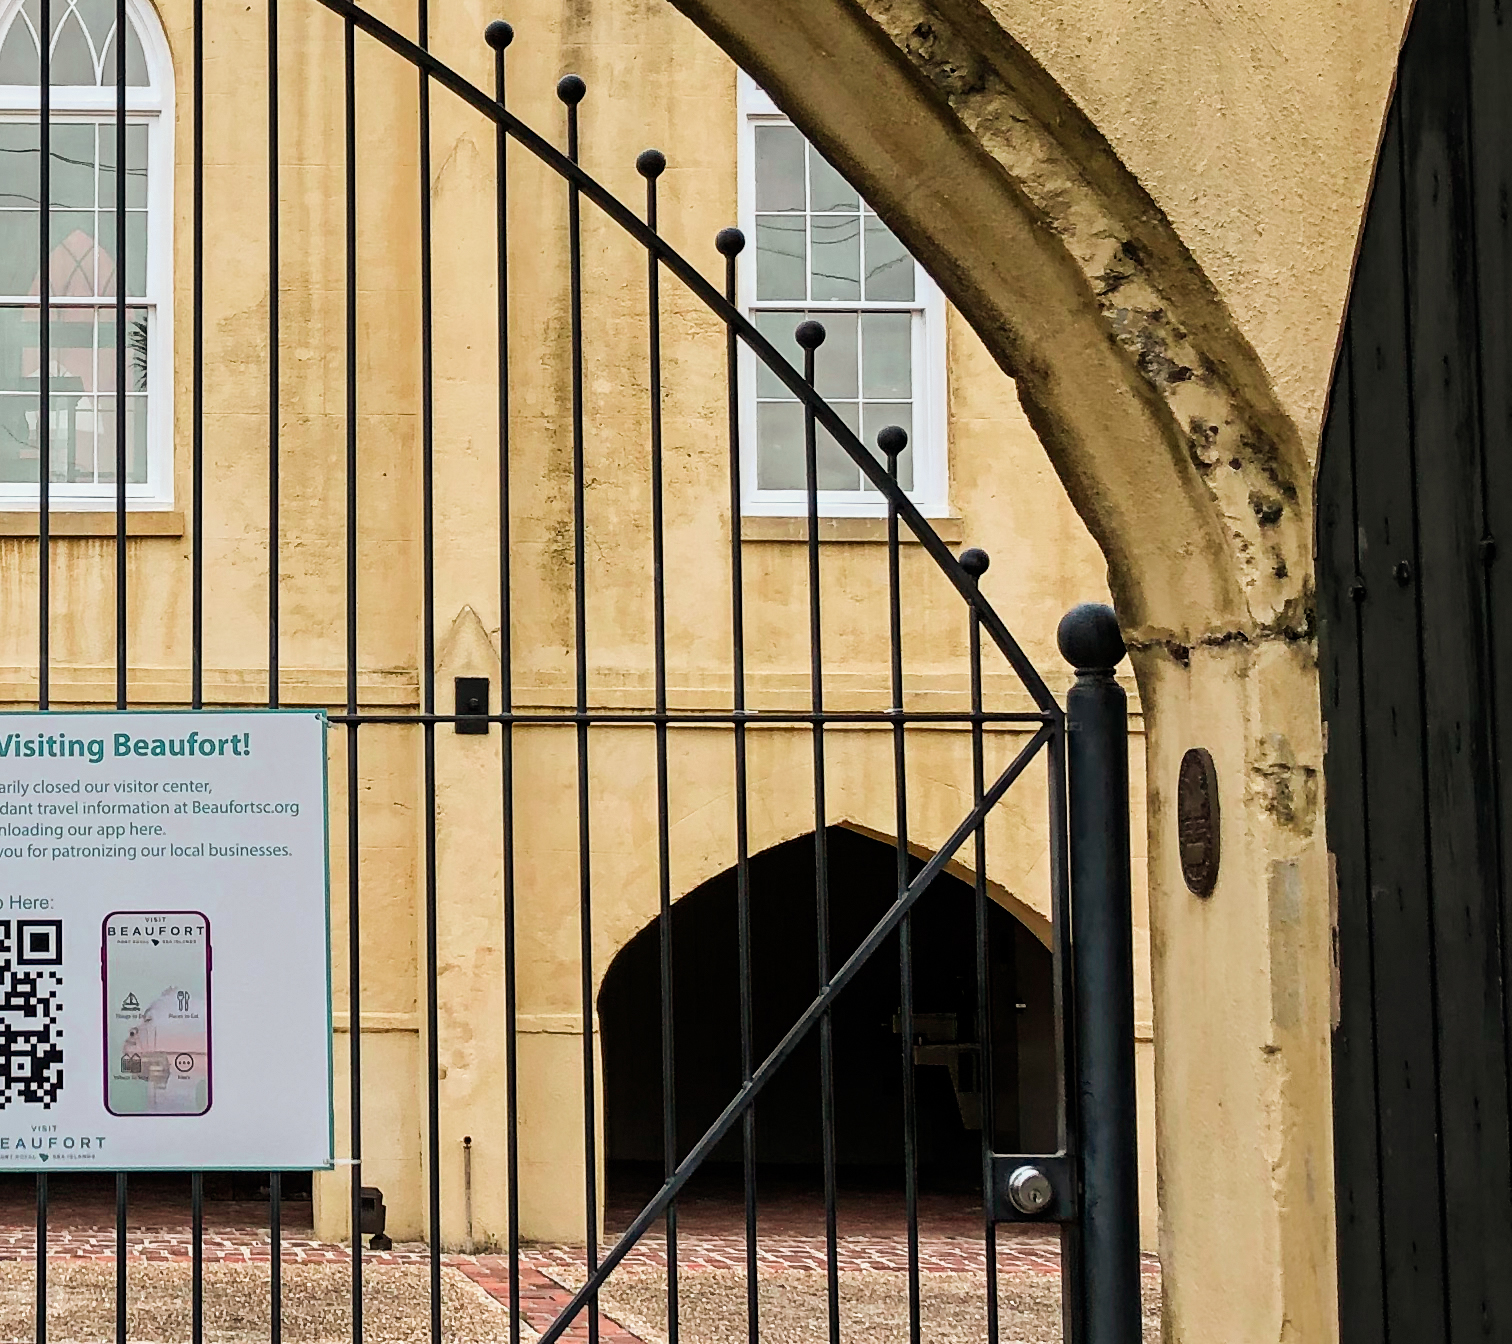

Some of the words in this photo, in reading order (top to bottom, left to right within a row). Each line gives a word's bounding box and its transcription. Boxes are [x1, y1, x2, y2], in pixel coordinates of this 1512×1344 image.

[113, 731, 251, 757] Beaufort!
[33, 780, 80, 794] closed
[85, 783, 110, 793] our
[114, 780, 158, 793] visitor
[162, 780, 212, 794] center,
[37, 801, 79, 814] travel
[83, 800, 170, 814] information
[174, 802, 188, 814] at
[192, 800, 300, 816] Beaufortsc.org
[68, 825, 92, 836] our
[97, 825, 125, 839] app
[130, 822, 166, 836] here.
[27, 844, 48, 857] for
[52, 843, 136, 860] patronizing
[141, 845, 166, 857] our
[170, 843, 204, 856] local
[209, 843, 292, 856] businesses.
[9, 895, 54, 910] Here:
[108, 926, 204, 936] BEAUFORT
